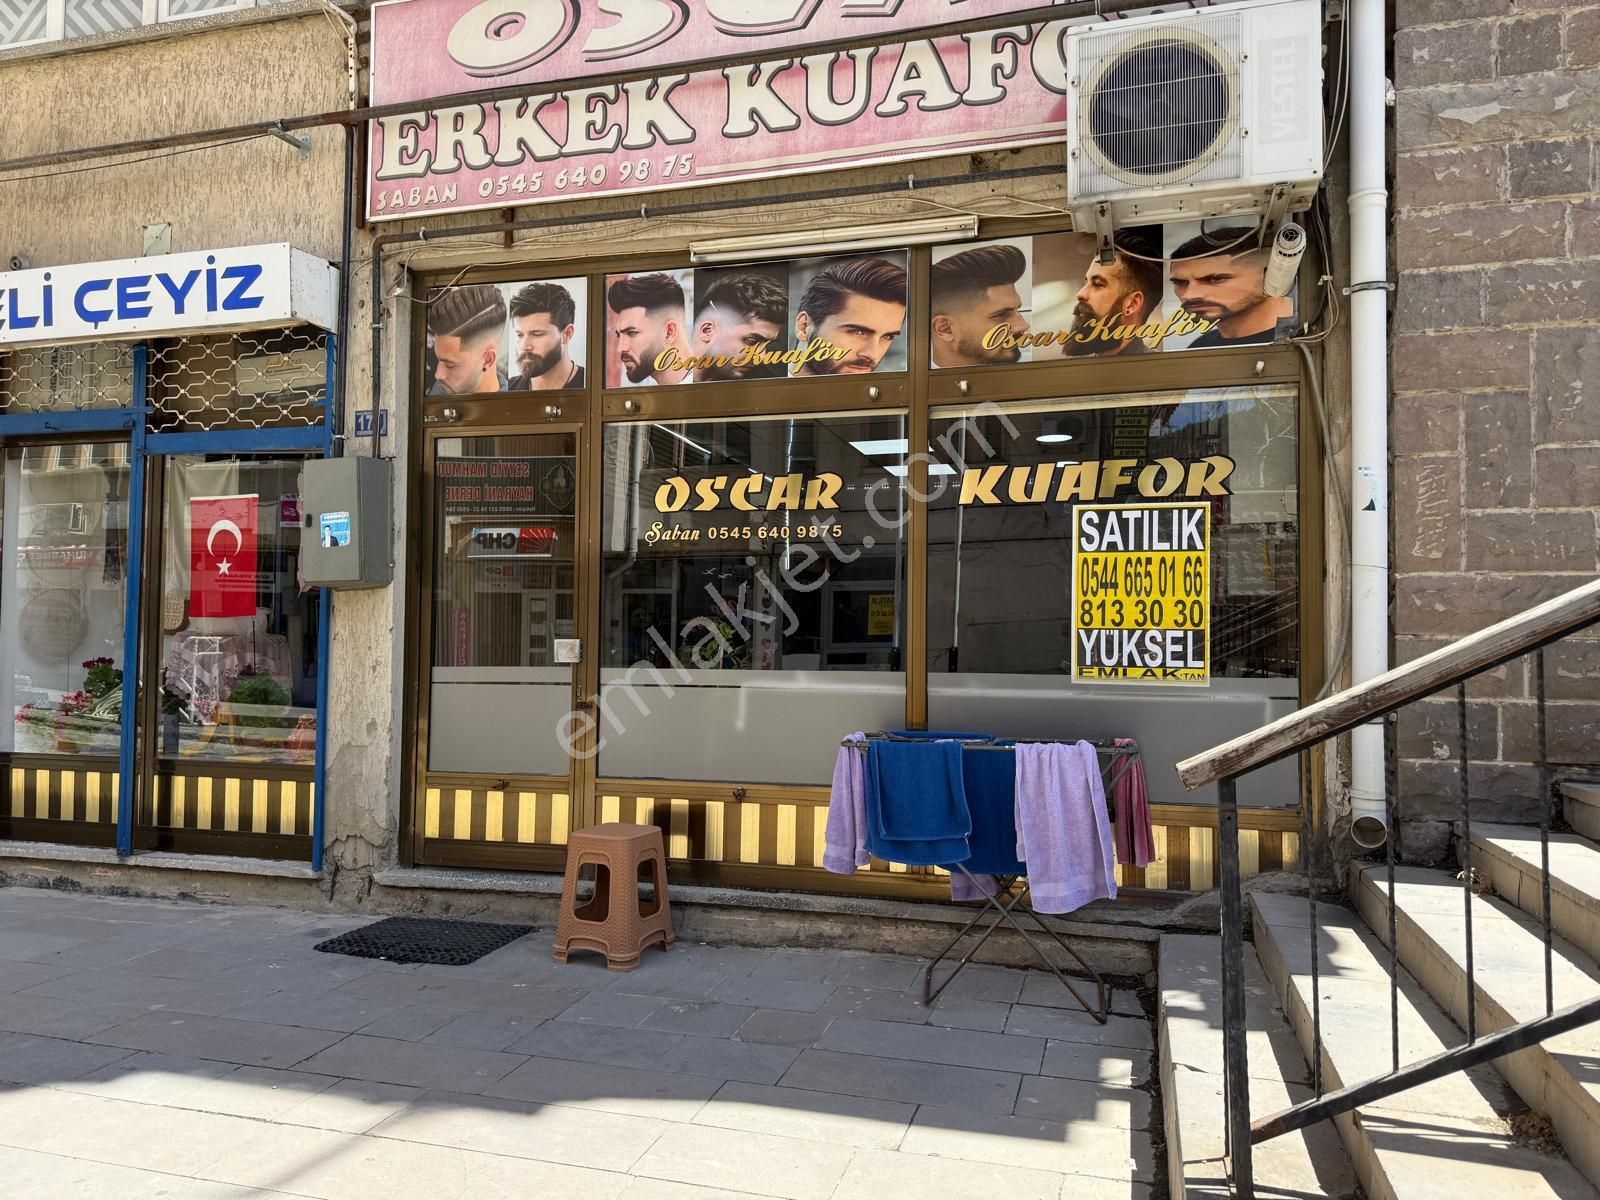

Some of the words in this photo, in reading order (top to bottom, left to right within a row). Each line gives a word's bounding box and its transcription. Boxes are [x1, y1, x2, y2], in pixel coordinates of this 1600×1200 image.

[376, 73, 696, 181] ERKEK
[722, 8, 1170, 138] KUAFO
[1271, 40, 1296, 141] VESTEL
[478, 172, 544, 199] 0545
[554, 164, 608, 191] 640
[619, 158, 651, 184] 98
[661, 153, 697, 178] 75
[0, 271, 54, 331] Lİ
[74, 254, 265, 331] ÇEYİZ
[982, 322, 1078, 351] Oscar
[1074, 307, 1220, 350] Kuaför
[653, 347, 734, 372] Oscar
[731, 337, 853, 374] Kuaför
[654, 472, 844, 513] OSCAR
[958, 455, 1237, 505] KUAFOR
[644, 521, 701, 547] Şaban
[707, 526, 751, 540] 0545
[757, 525, 790, 539] 640
[796, 524, 843, 538] 9875
[1080, 508, 1205, 552] SATILIK
[1081, 555, 1119, 598] 0544
[1124, 555, 1153, 598] 665
[1158, 555, 1176, 598] 01
[1183, 555, 1203, 598] 66
[1080, 599, 1125, 628] 813
[1133, 599, 1164, 628] 30
[1173, 599, 1204, 628] 30
[1078, 628, 1205, 669] YÜKSEL
